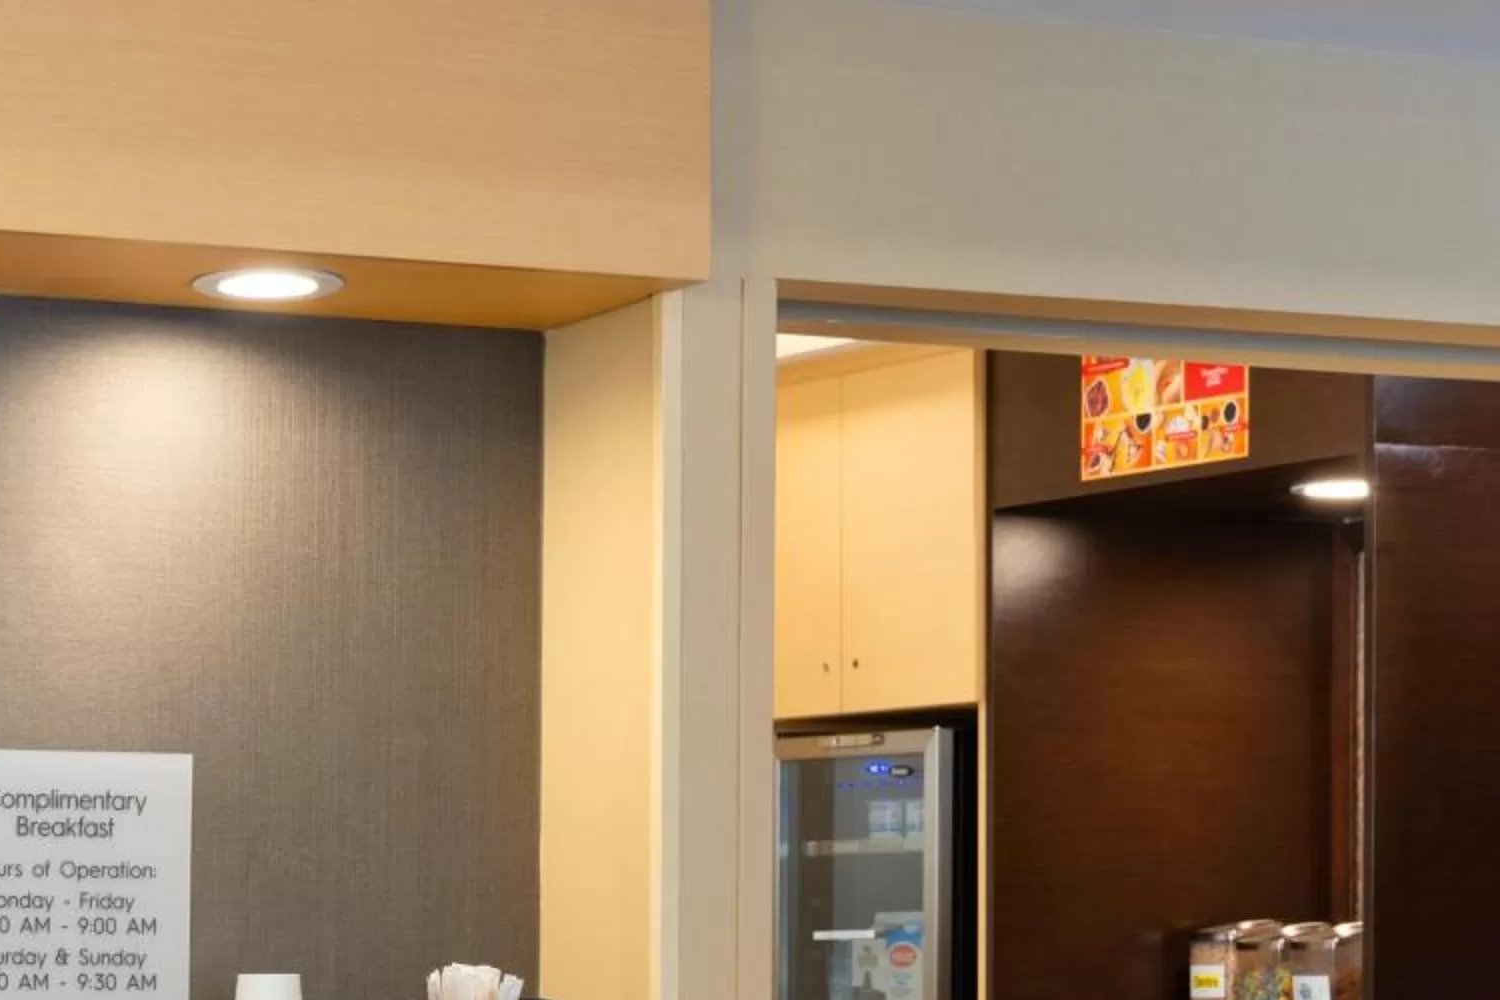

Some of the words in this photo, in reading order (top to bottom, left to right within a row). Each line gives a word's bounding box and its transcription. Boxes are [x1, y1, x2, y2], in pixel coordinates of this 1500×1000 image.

[15, 815, 115, 838] Breakfast
[31, 860, 51, 878] of
[59, 860, 157, 880] Operation:
[78, 891, 136, 912] Friday
[19, 917, 51, 934] AM
[77, 917, 117, 935] 9:00
[126, 918, 157, 936] AM
[54, 948, 69, 966] &
[78, 948, 148, 968] Sunday
[18, 974, 49, 991] AM
[76, 973, 117, 991] 9:30
[125, 974, 157, 991] AM
